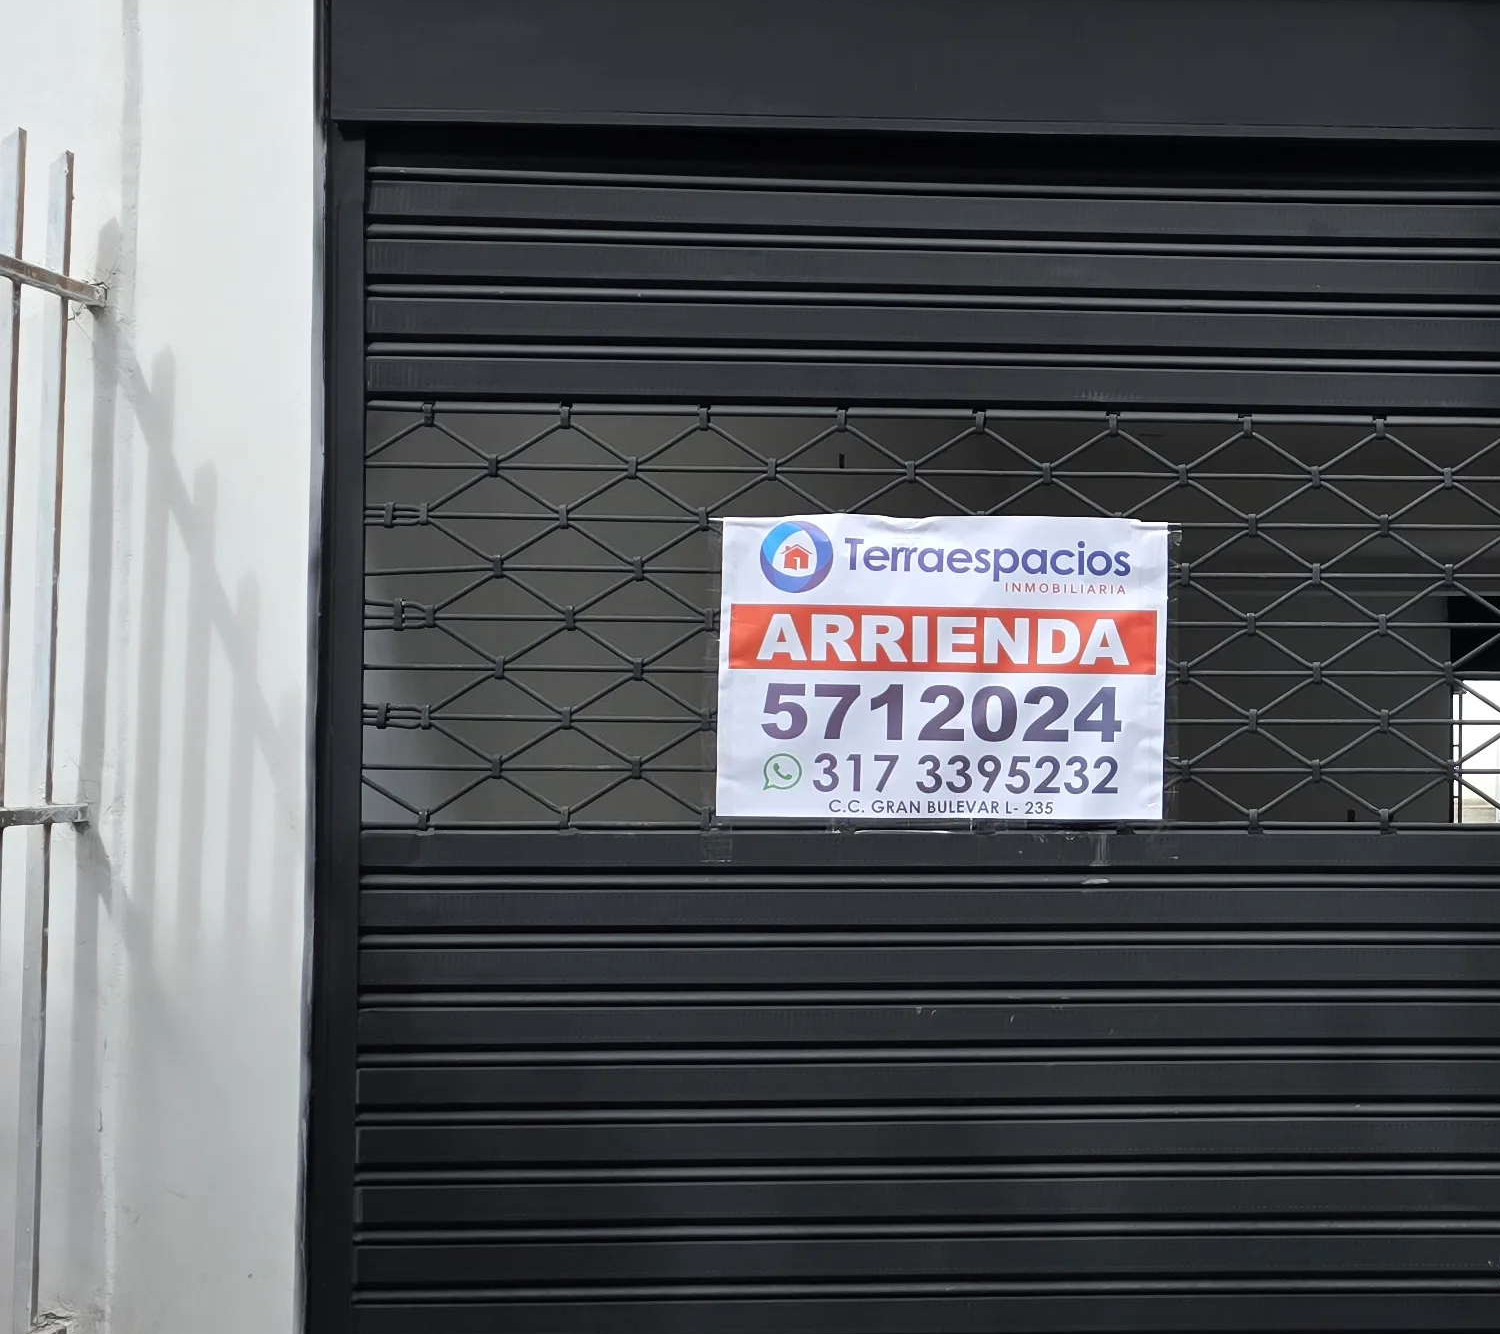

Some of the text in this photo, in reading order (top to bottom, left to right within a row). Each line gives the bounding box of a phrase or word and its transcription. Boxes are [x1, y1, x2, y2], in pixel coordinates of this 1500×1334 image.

[845, 537, 1131, 582] Terraespacios
[1004, 581, 1127, 595] INMOBILIARIA
[757, 613, 1130, 666] ARRIENDA
[760, 682, 1122, 743] 5712024
[812, 753, 1119, 795] 317 3395232
[828, 799, 865, 814] C.C.
[871, 799, 921, 815] GRAN
[927, 799, 1000, 815] BULEVAR
[1024, 801, 1054, 816] 235
